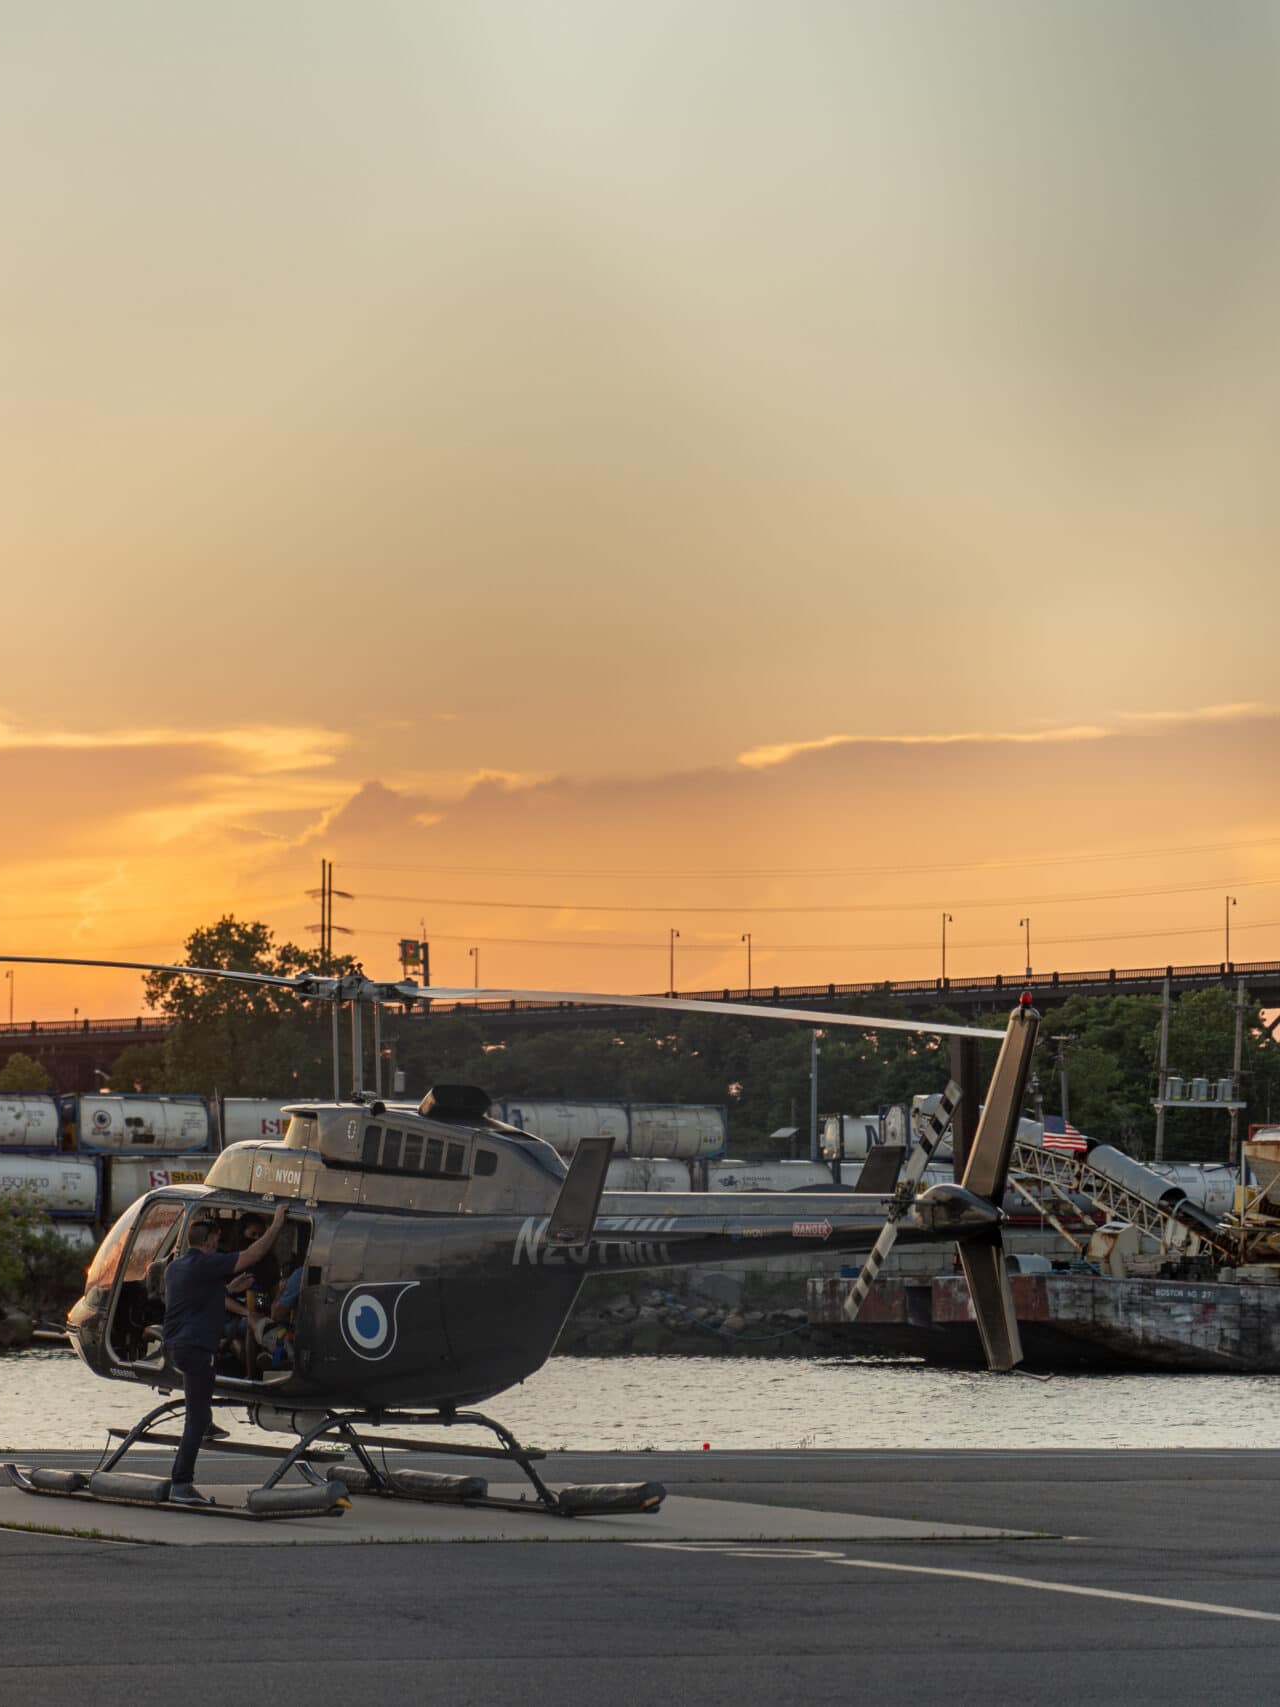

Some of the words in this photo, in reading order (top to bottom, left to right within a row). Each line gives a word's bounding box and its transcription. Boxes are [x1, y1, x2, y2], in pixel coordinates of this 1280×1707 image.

[172, 1172, 204, 1183] Stolt
[276, 1168, 302, 1185] NYON
[794, 1224, 828, 1235] DANGER
[1155, 1288, 1184, 1297] BOSTON
